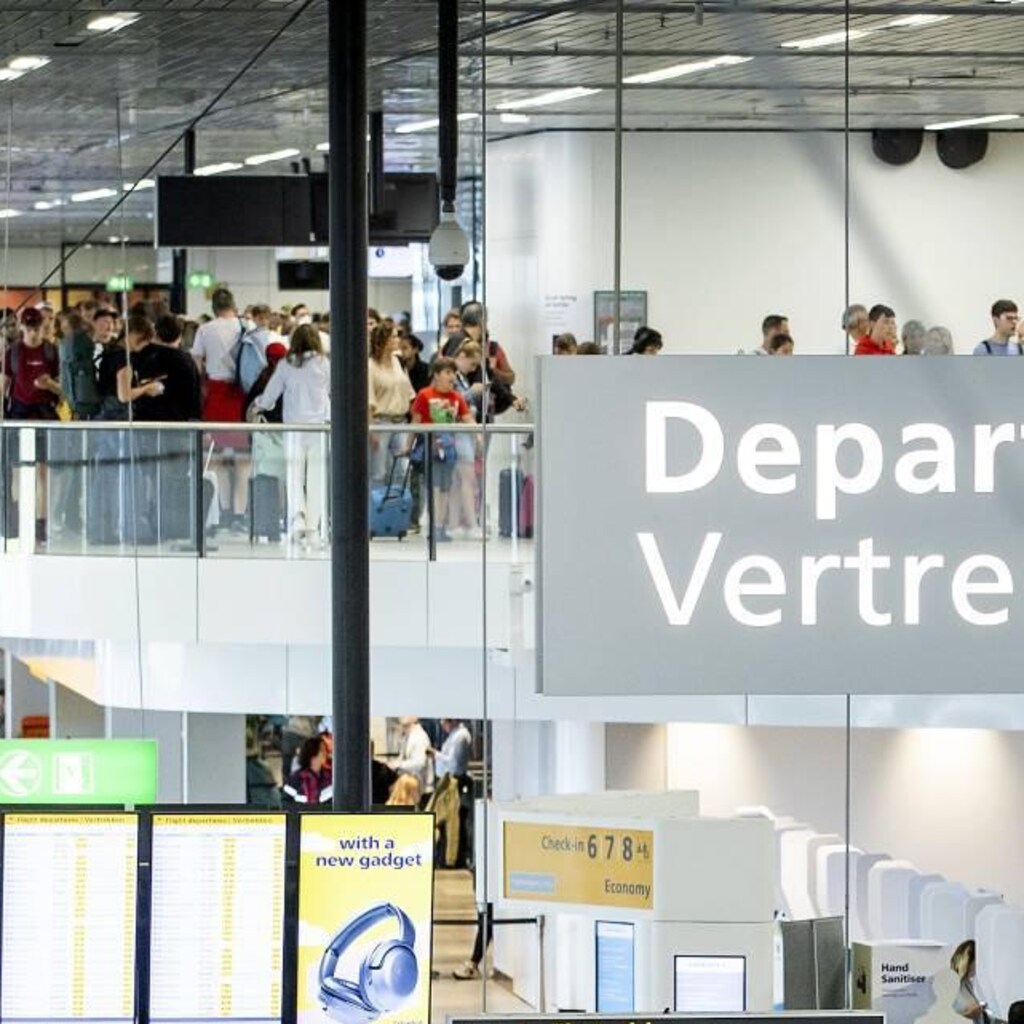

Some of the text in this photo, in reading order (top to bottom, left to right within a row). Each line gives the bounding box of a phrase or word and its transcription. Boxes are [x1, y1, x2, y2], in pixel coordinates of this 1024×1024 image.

[339, 835, 395, 850] with a
[541, 834, 633, 861] Check-in 6 7 8
[316, 852, 422, 870] new gadget
[604, 880, 651, 900] Economy
[881, 963, 909, 972] Hand
